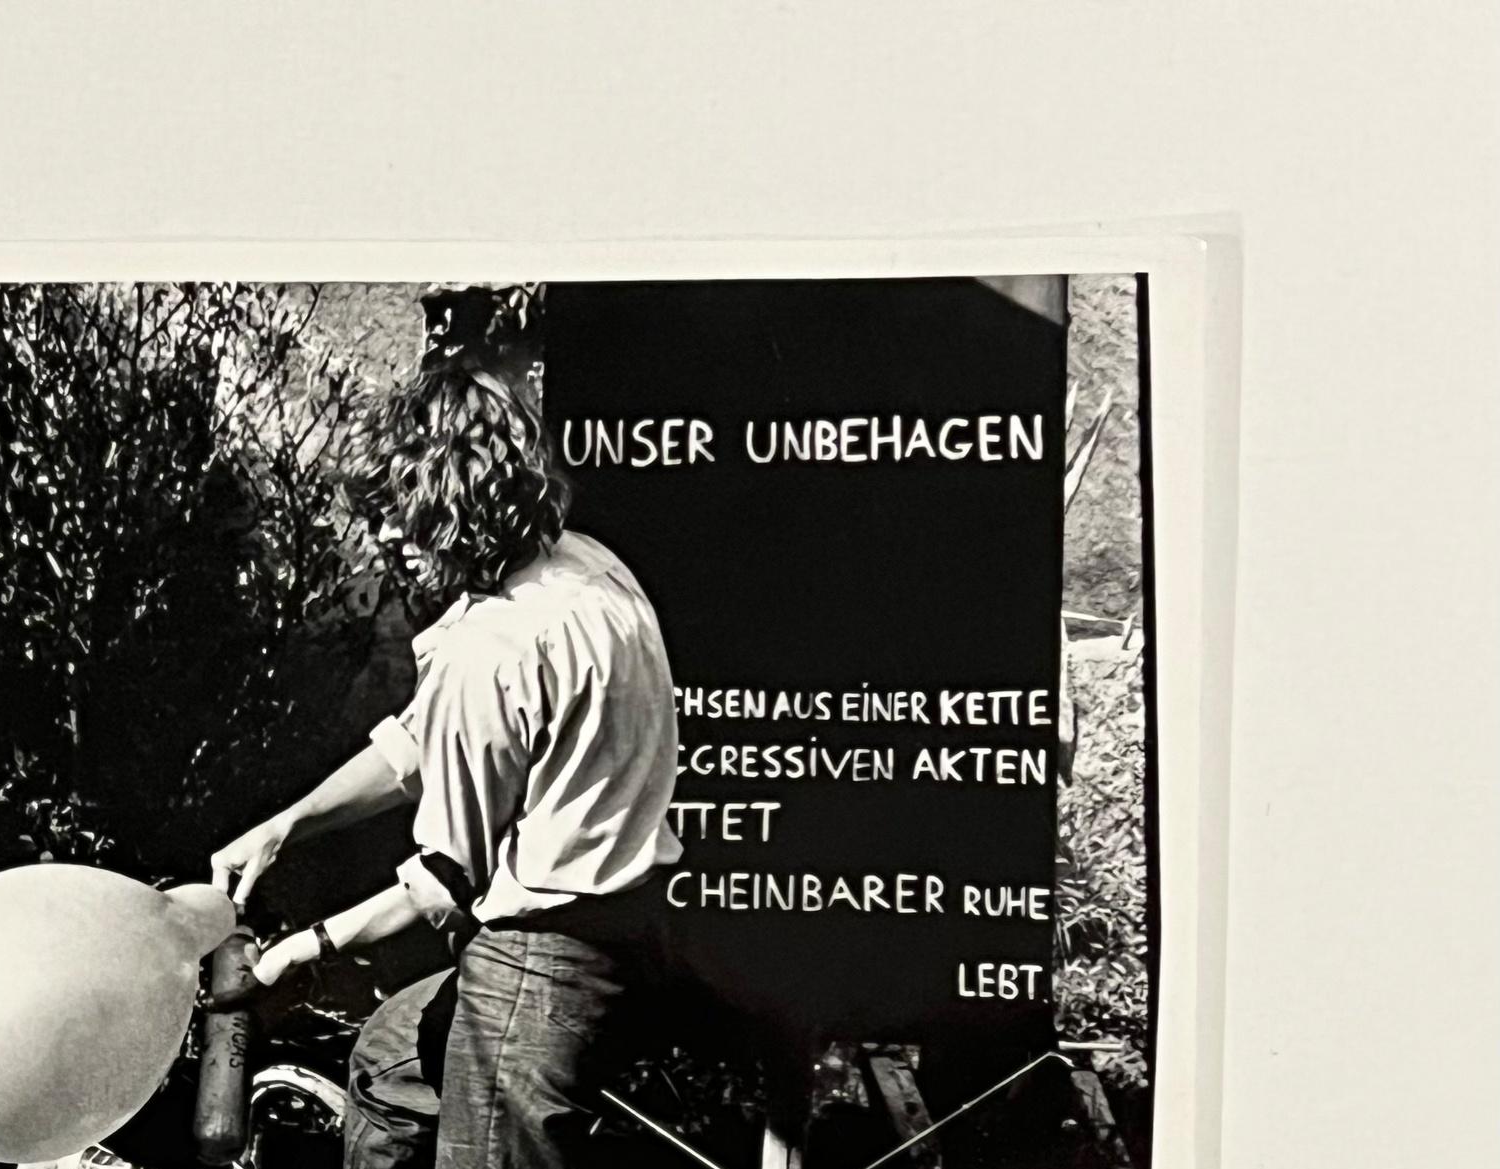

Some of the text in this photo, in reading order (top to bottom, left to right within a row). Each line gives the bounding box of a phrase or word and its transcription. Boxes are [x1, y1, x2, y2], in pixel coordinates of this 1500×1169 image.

[562, 413, 1044, 468] UNSER UNBEHAGEN
[772, 690, 833, 721] AUS
[939, 689, 1052, 726] KETTE
[912, 747, 1047, 786] AKTEN
[669, 801, 782, 843] TTET
[666, 871, 1051, 921] CHEINBARER RUHE
[958, 962, 1050, 1004] LEBT.
